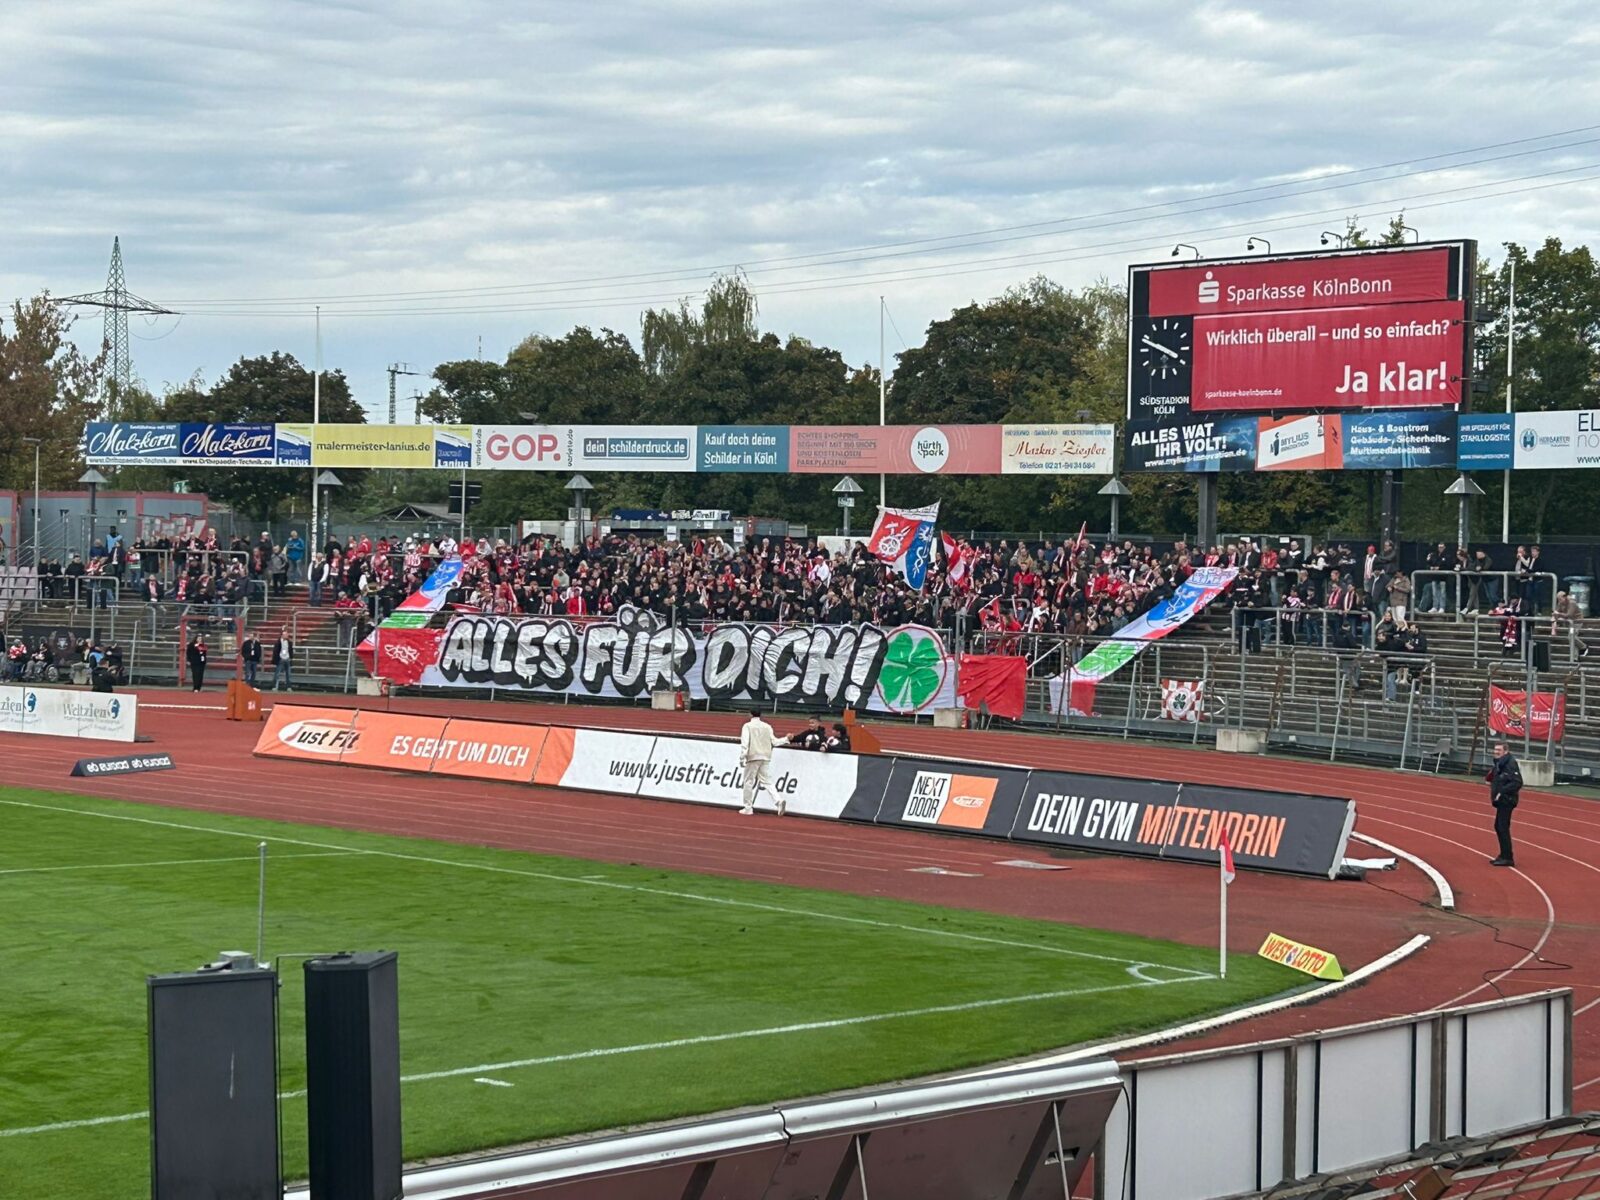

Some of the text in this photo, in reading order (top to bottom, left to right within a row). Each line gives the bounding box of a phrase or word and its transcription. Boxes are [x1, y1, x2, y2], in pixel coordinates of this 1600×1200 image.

[1227, 283, 1305, 305] Sparkasse
[1313, 277, 1392, 297] KölnBonn
[1206, 328, 1263, 346] Wirklich
[1267, 325, 1316, 344] überall
[1332, 323, 1359, 340] und
[1364, 327, 1382, 340] so
[1386, 319, 1450, 338] einfach?
[1335, 361, 1447, 394] Ja klar!
[1153, 405, 1175, 414] KÖLN
[89, 424, 177, 455] Malzkorn
[705, 433, 776, 446] Kauf doch deine
[1131, 422, 1214, 447] ALLES WAT
[1280, 432, 1309, 447] MYLIUS
[1378, 424, 1385, 432] &
[1387, 423, 1429, 433] Baustrom
[1397, 434, 1450, 444] Sicherheits-
[182, 424, 272, 456] Malzkorn
[486, 434, 561, 462] GOP.
[586, 440, 685, 454] dein schilderdruck.de
[917, 440, 942, 451] hürth
[1060, 440, 1107, 459] Ziegler
[1155, 436, 1227, 458] IHR VOLT!
[1350, 445, 1431, 455] Multimediatechnik
[704, 451, 777, 466] Schilder in Köln!
[440, 605, 886, 706] ALLES FÜR DICH!
[284, 722, 329, 746] Just
[389, 735, 530, 768] ES GEHT UM DICH
[914, 775, 948, 798] NEXT
[907, 796, 941, 819] DOOR
[1027, 793, 1287, 858] DEIN GYM MITTENDRIN
